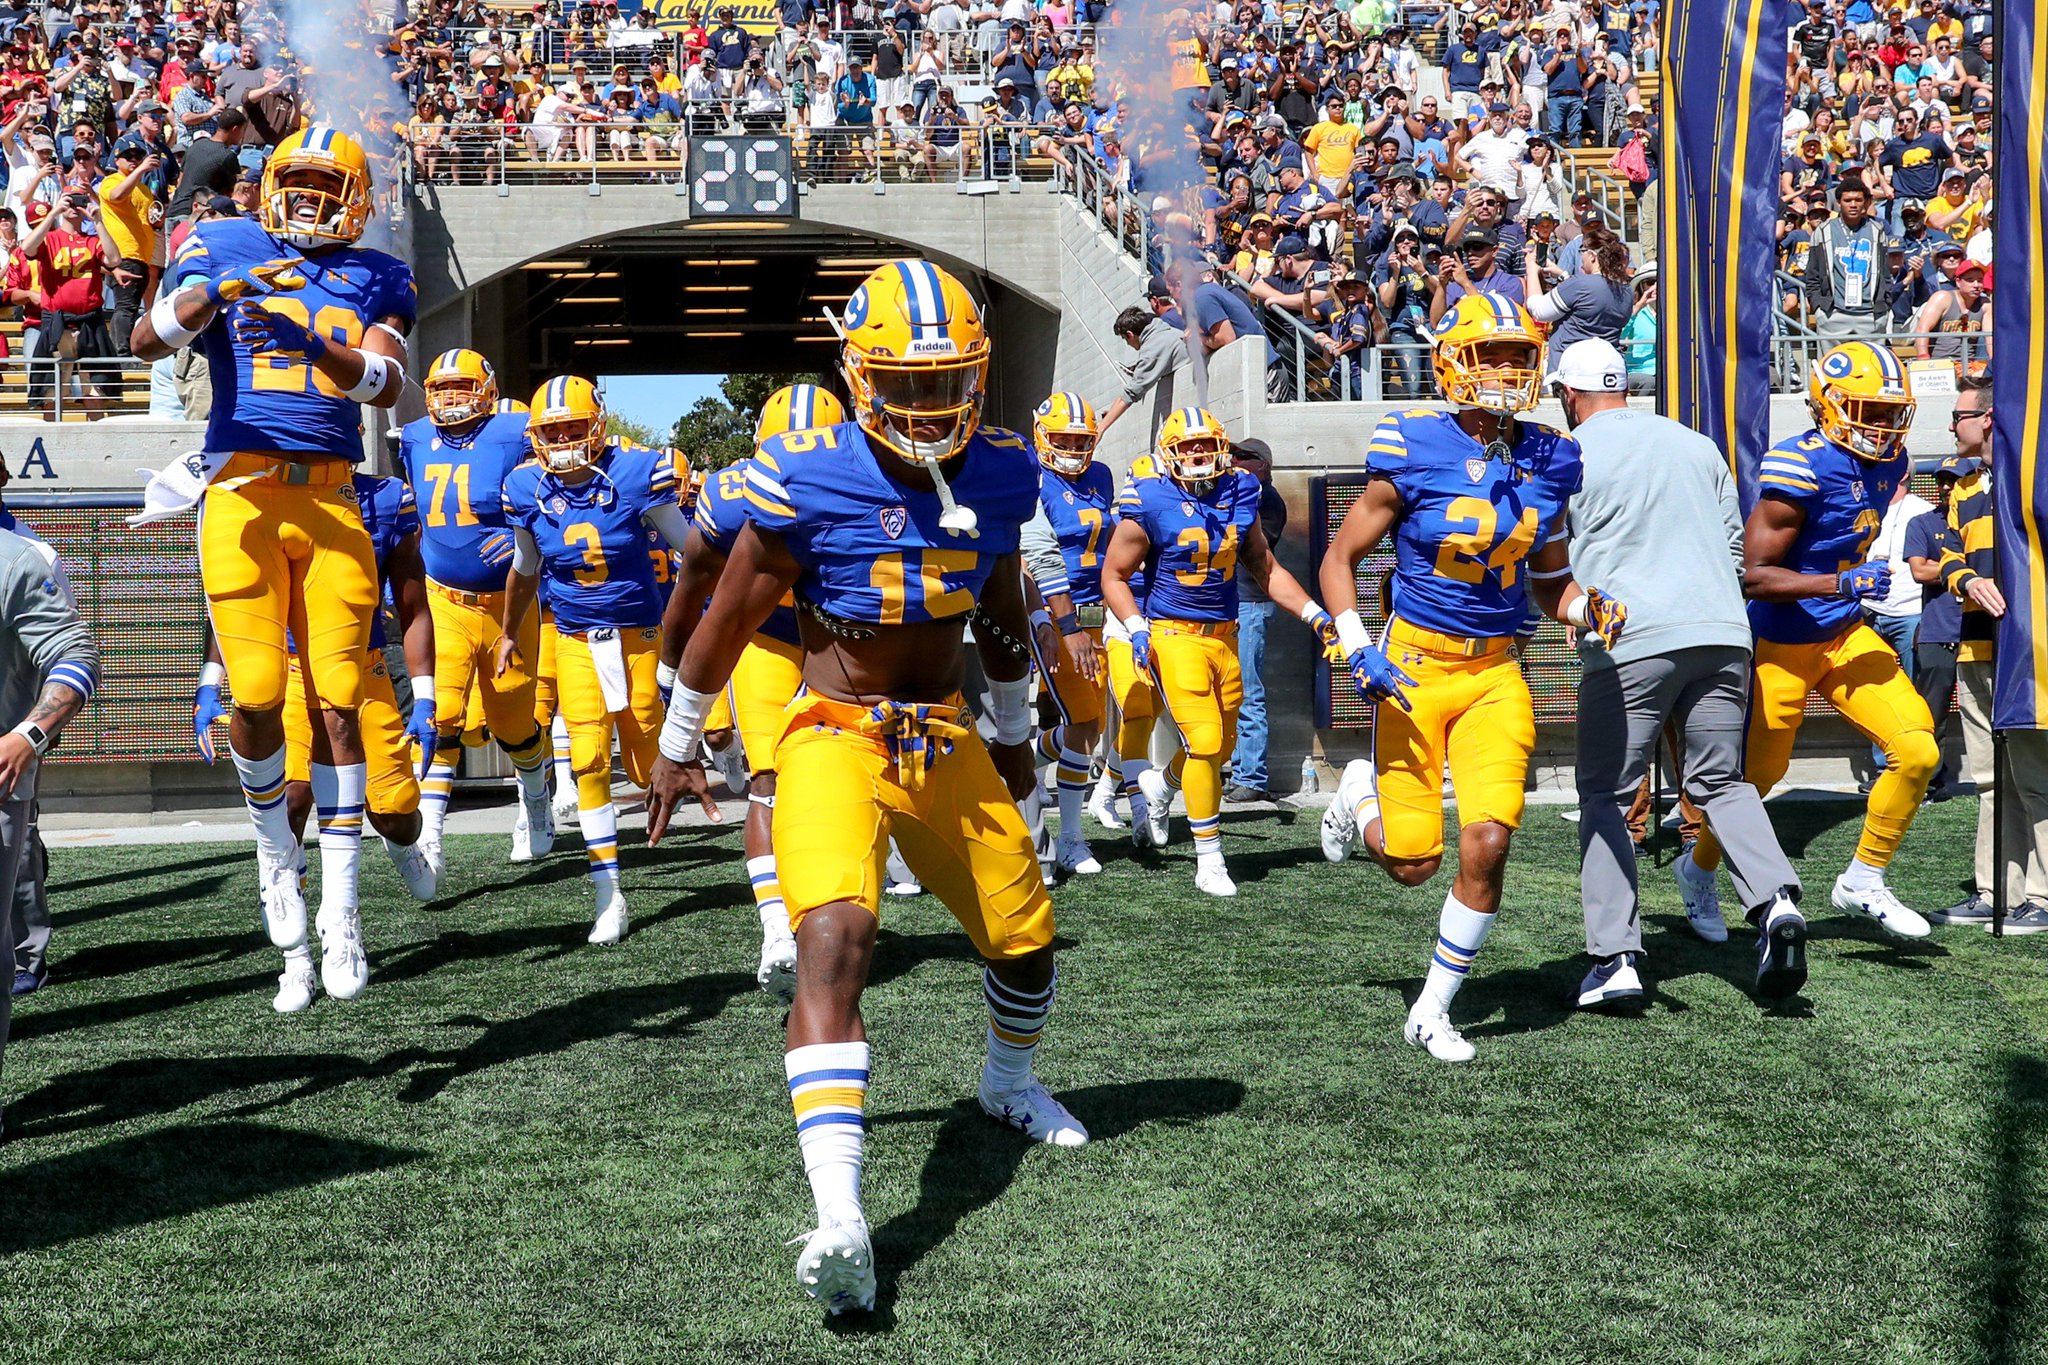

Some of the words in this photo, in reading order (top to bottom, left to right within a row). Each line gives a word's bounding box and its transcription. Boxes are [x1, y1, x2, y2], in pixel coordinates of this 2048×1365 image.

[722, 31, 740, 45] Cal
[1460, 50, 1478, 63] Cal
[1327, 132, 1351, 146] Cal
[694, 140, 787, 213] 25
[54, 246, 92, 279] 42
[914, 342, 952, 352] Riddell
[424, 463, 480, 528] 71
[888, 521, 900, 533] 12
[1077, 508, 1103, 568] 7
[1432, 496, 1539, 591] 24
[562, 521, 611, 588] 3
[1174, 524, 1240, 587] 34
[869, 548, 978, 625] 15
[595, 628, 614, 641] Cal
